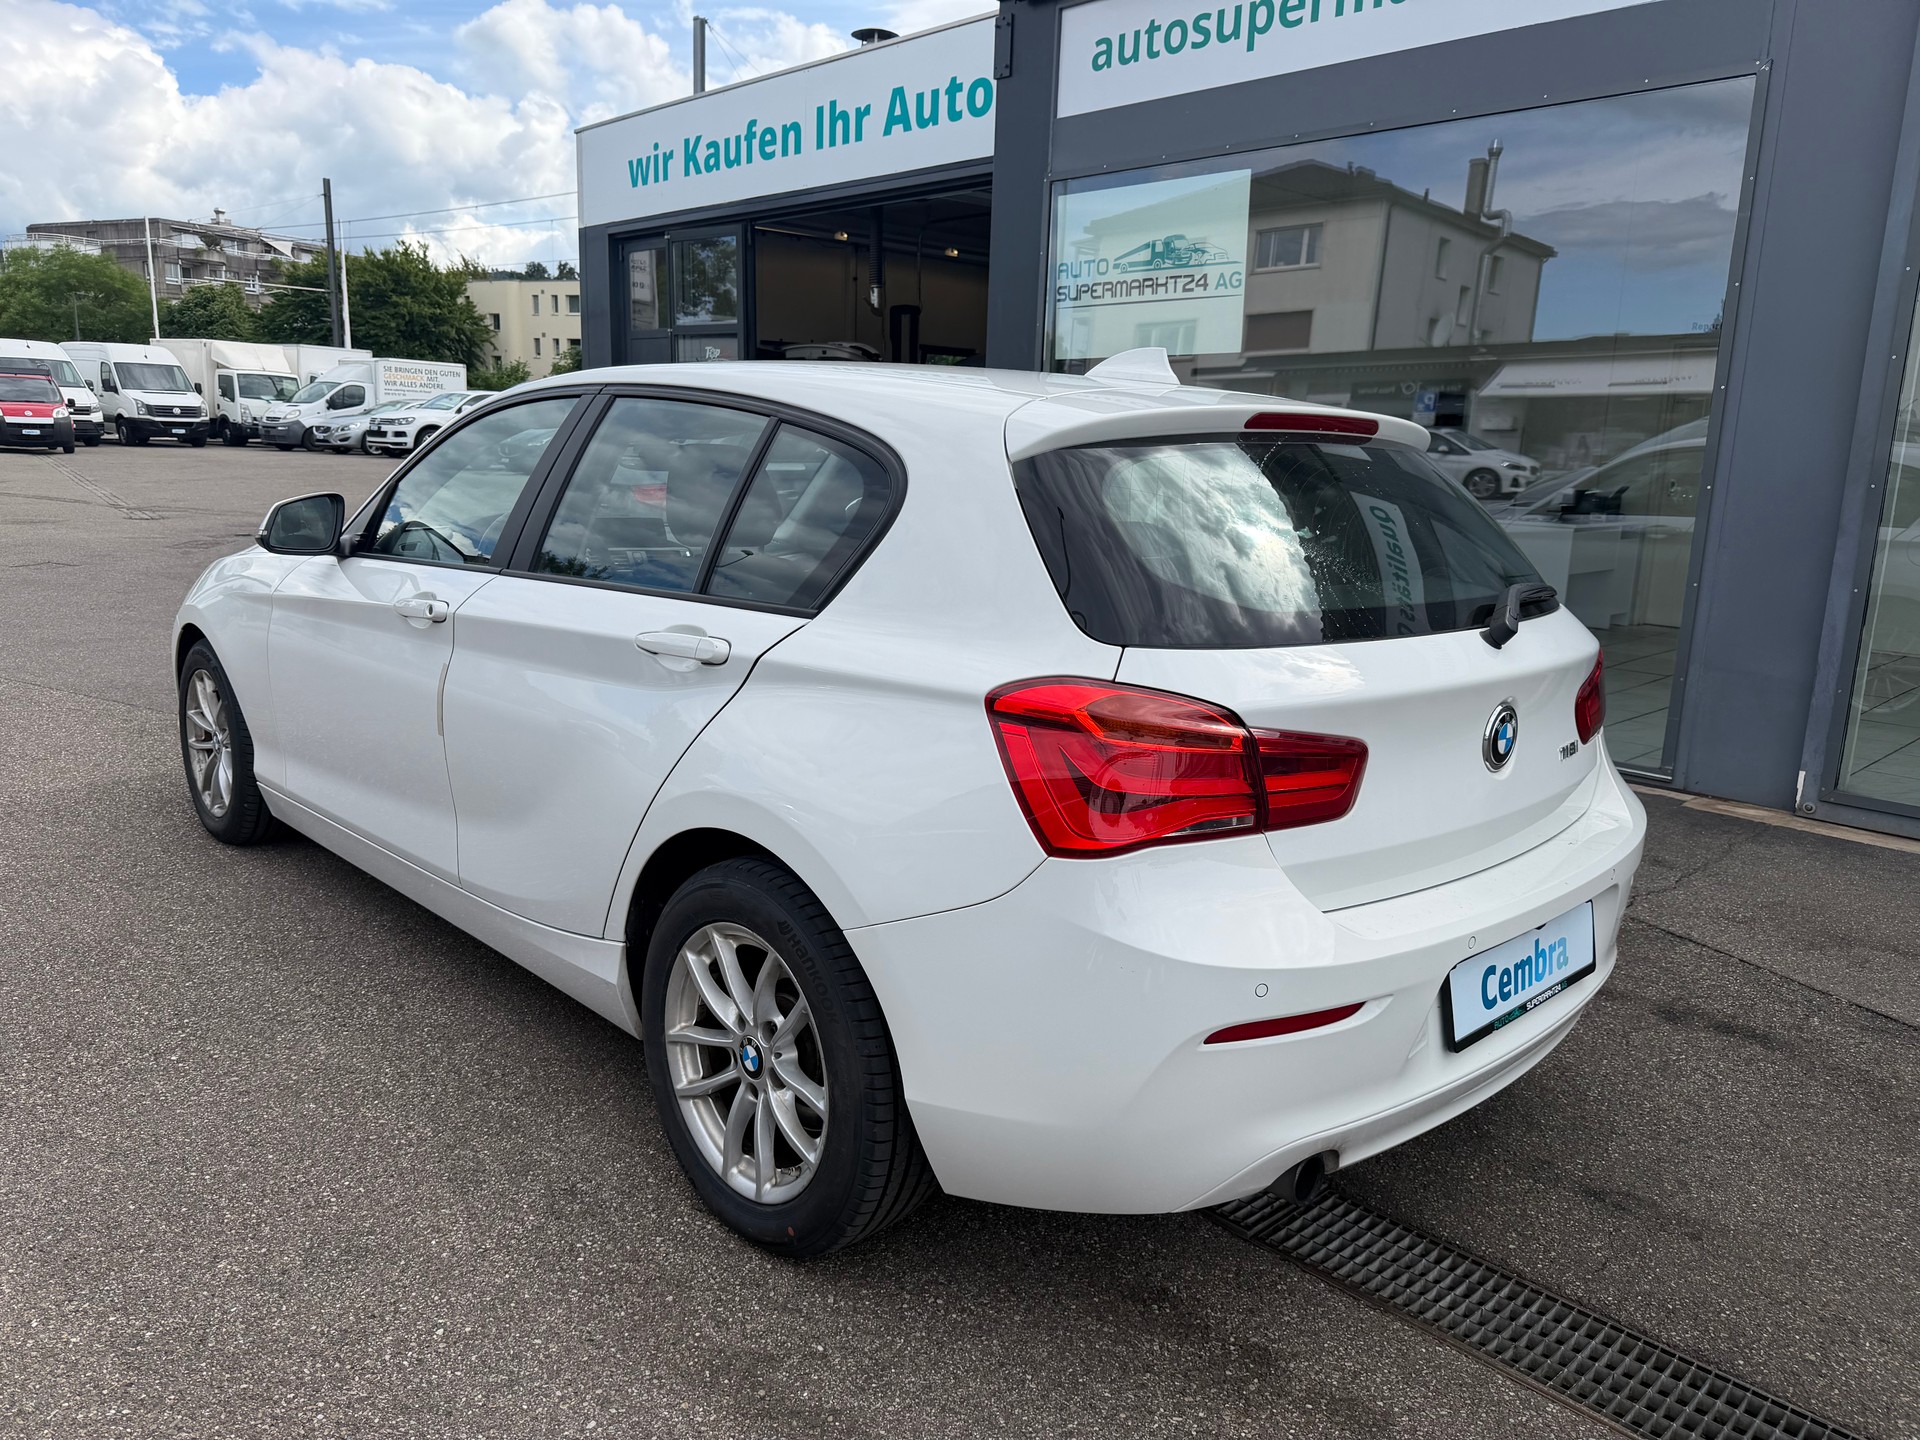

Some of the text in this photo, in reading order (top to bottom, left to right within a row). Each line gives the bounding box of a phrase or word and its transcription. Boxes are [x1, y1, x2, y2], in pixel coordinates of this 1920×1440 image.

[628, 75, 994, 188] wir Kaufen Ihr Auto
[1057, 258, 1109, 280] AUTO
[1214, 271, 1243, 291] AG
[383, 365, 393, 373] SIE
[394, 366, 423, 375] BRINGEN
[439, 370, 460, 378] GUTEN
[384, 373, 425, 382] GESCHMACK
[399, 381, 418, 389] ALLES
[1481, 936, 1569, 1011] Cembra
